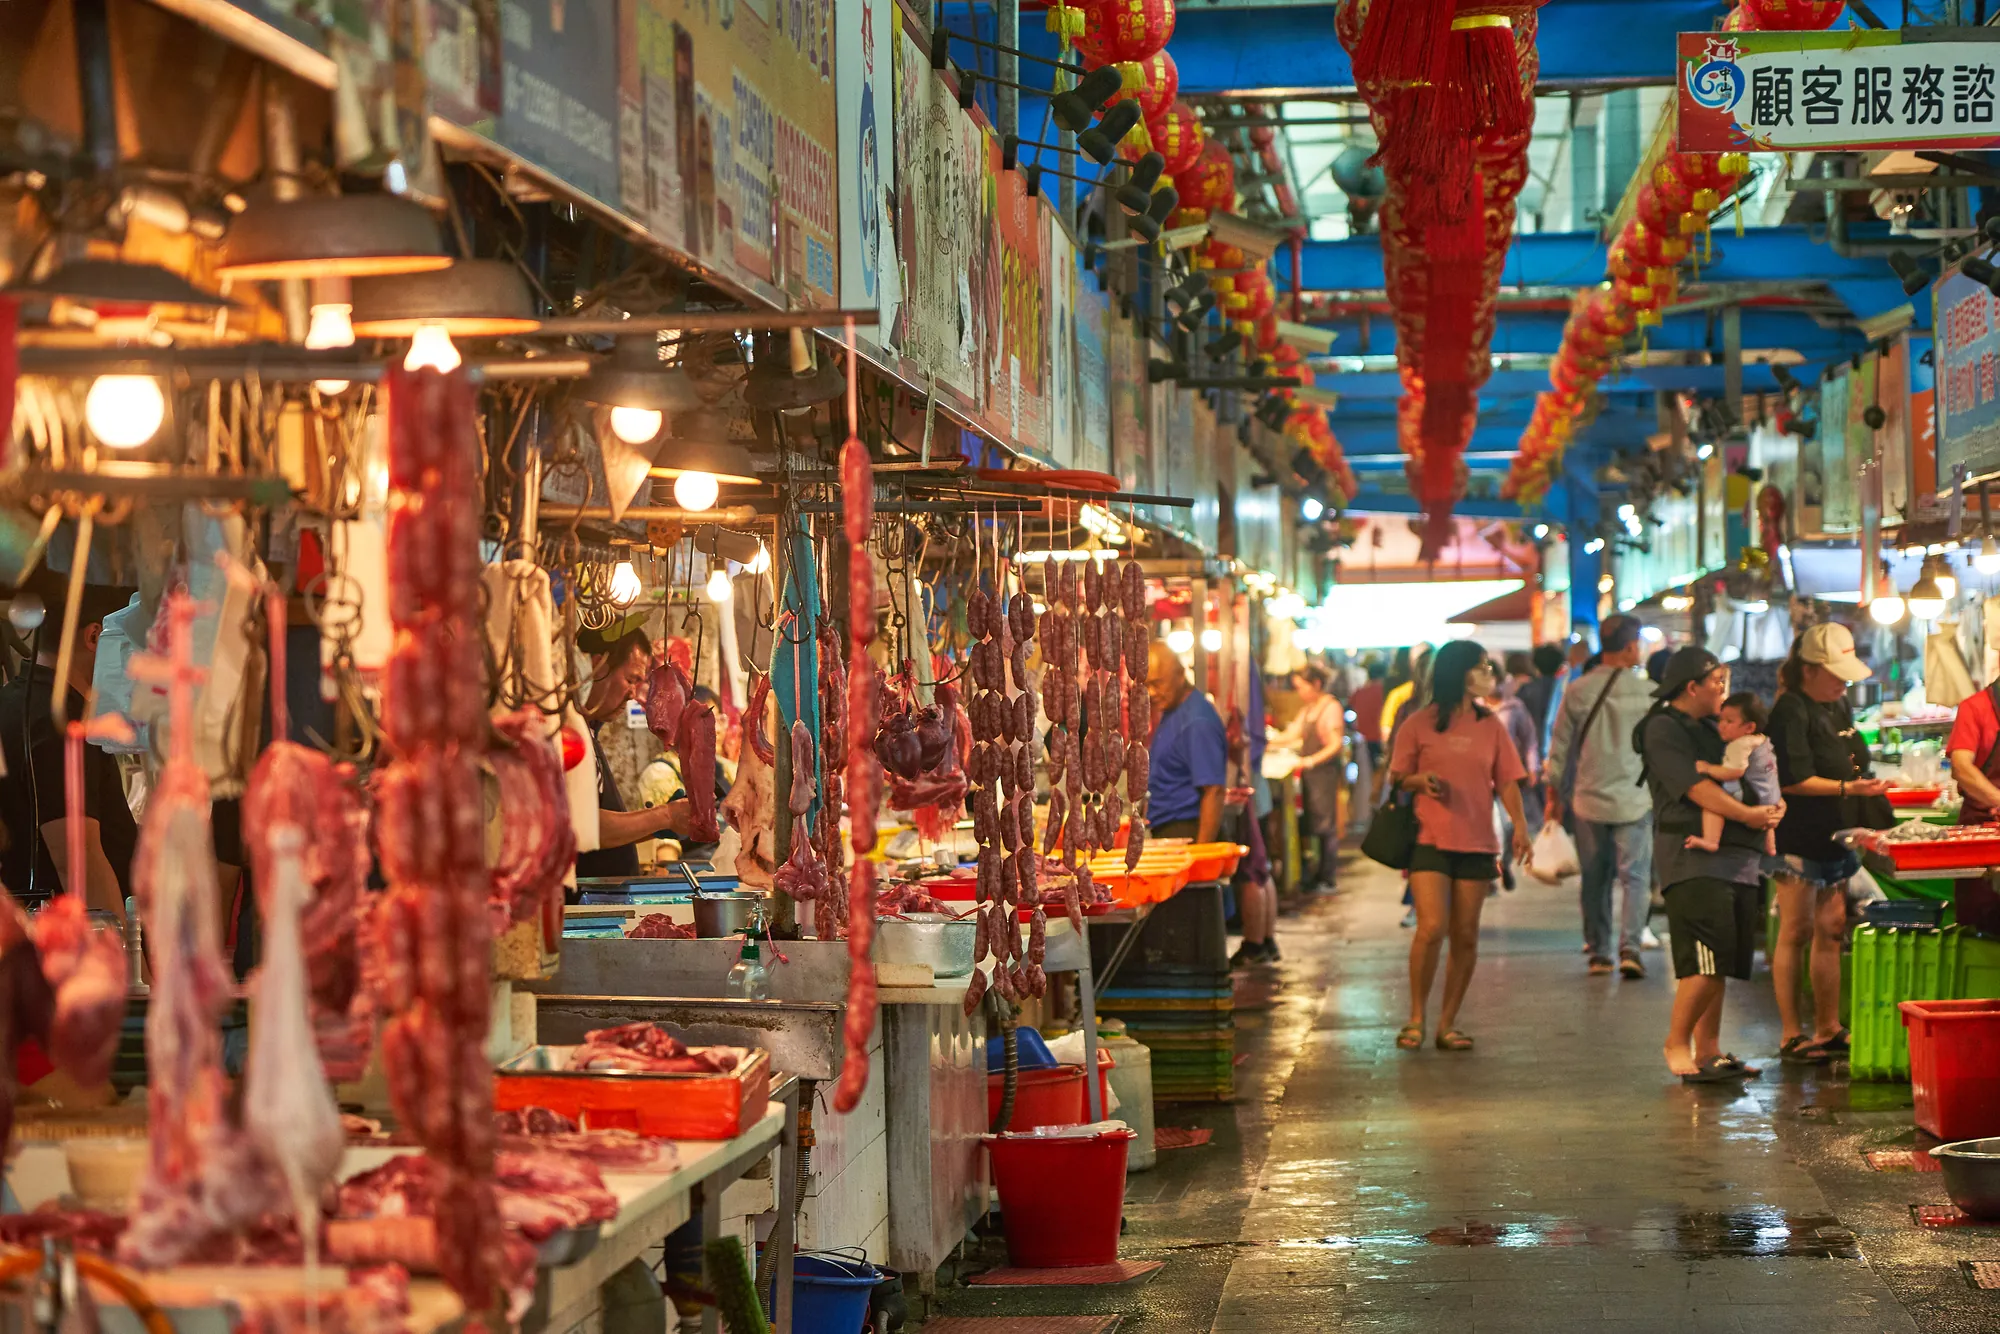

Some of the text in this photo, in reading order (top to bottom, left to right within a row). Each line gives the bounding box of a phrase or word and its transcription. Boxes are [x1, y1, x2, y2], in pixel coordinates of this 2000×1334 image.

[1751, 63, 1996, 127] 顧客服務諮
